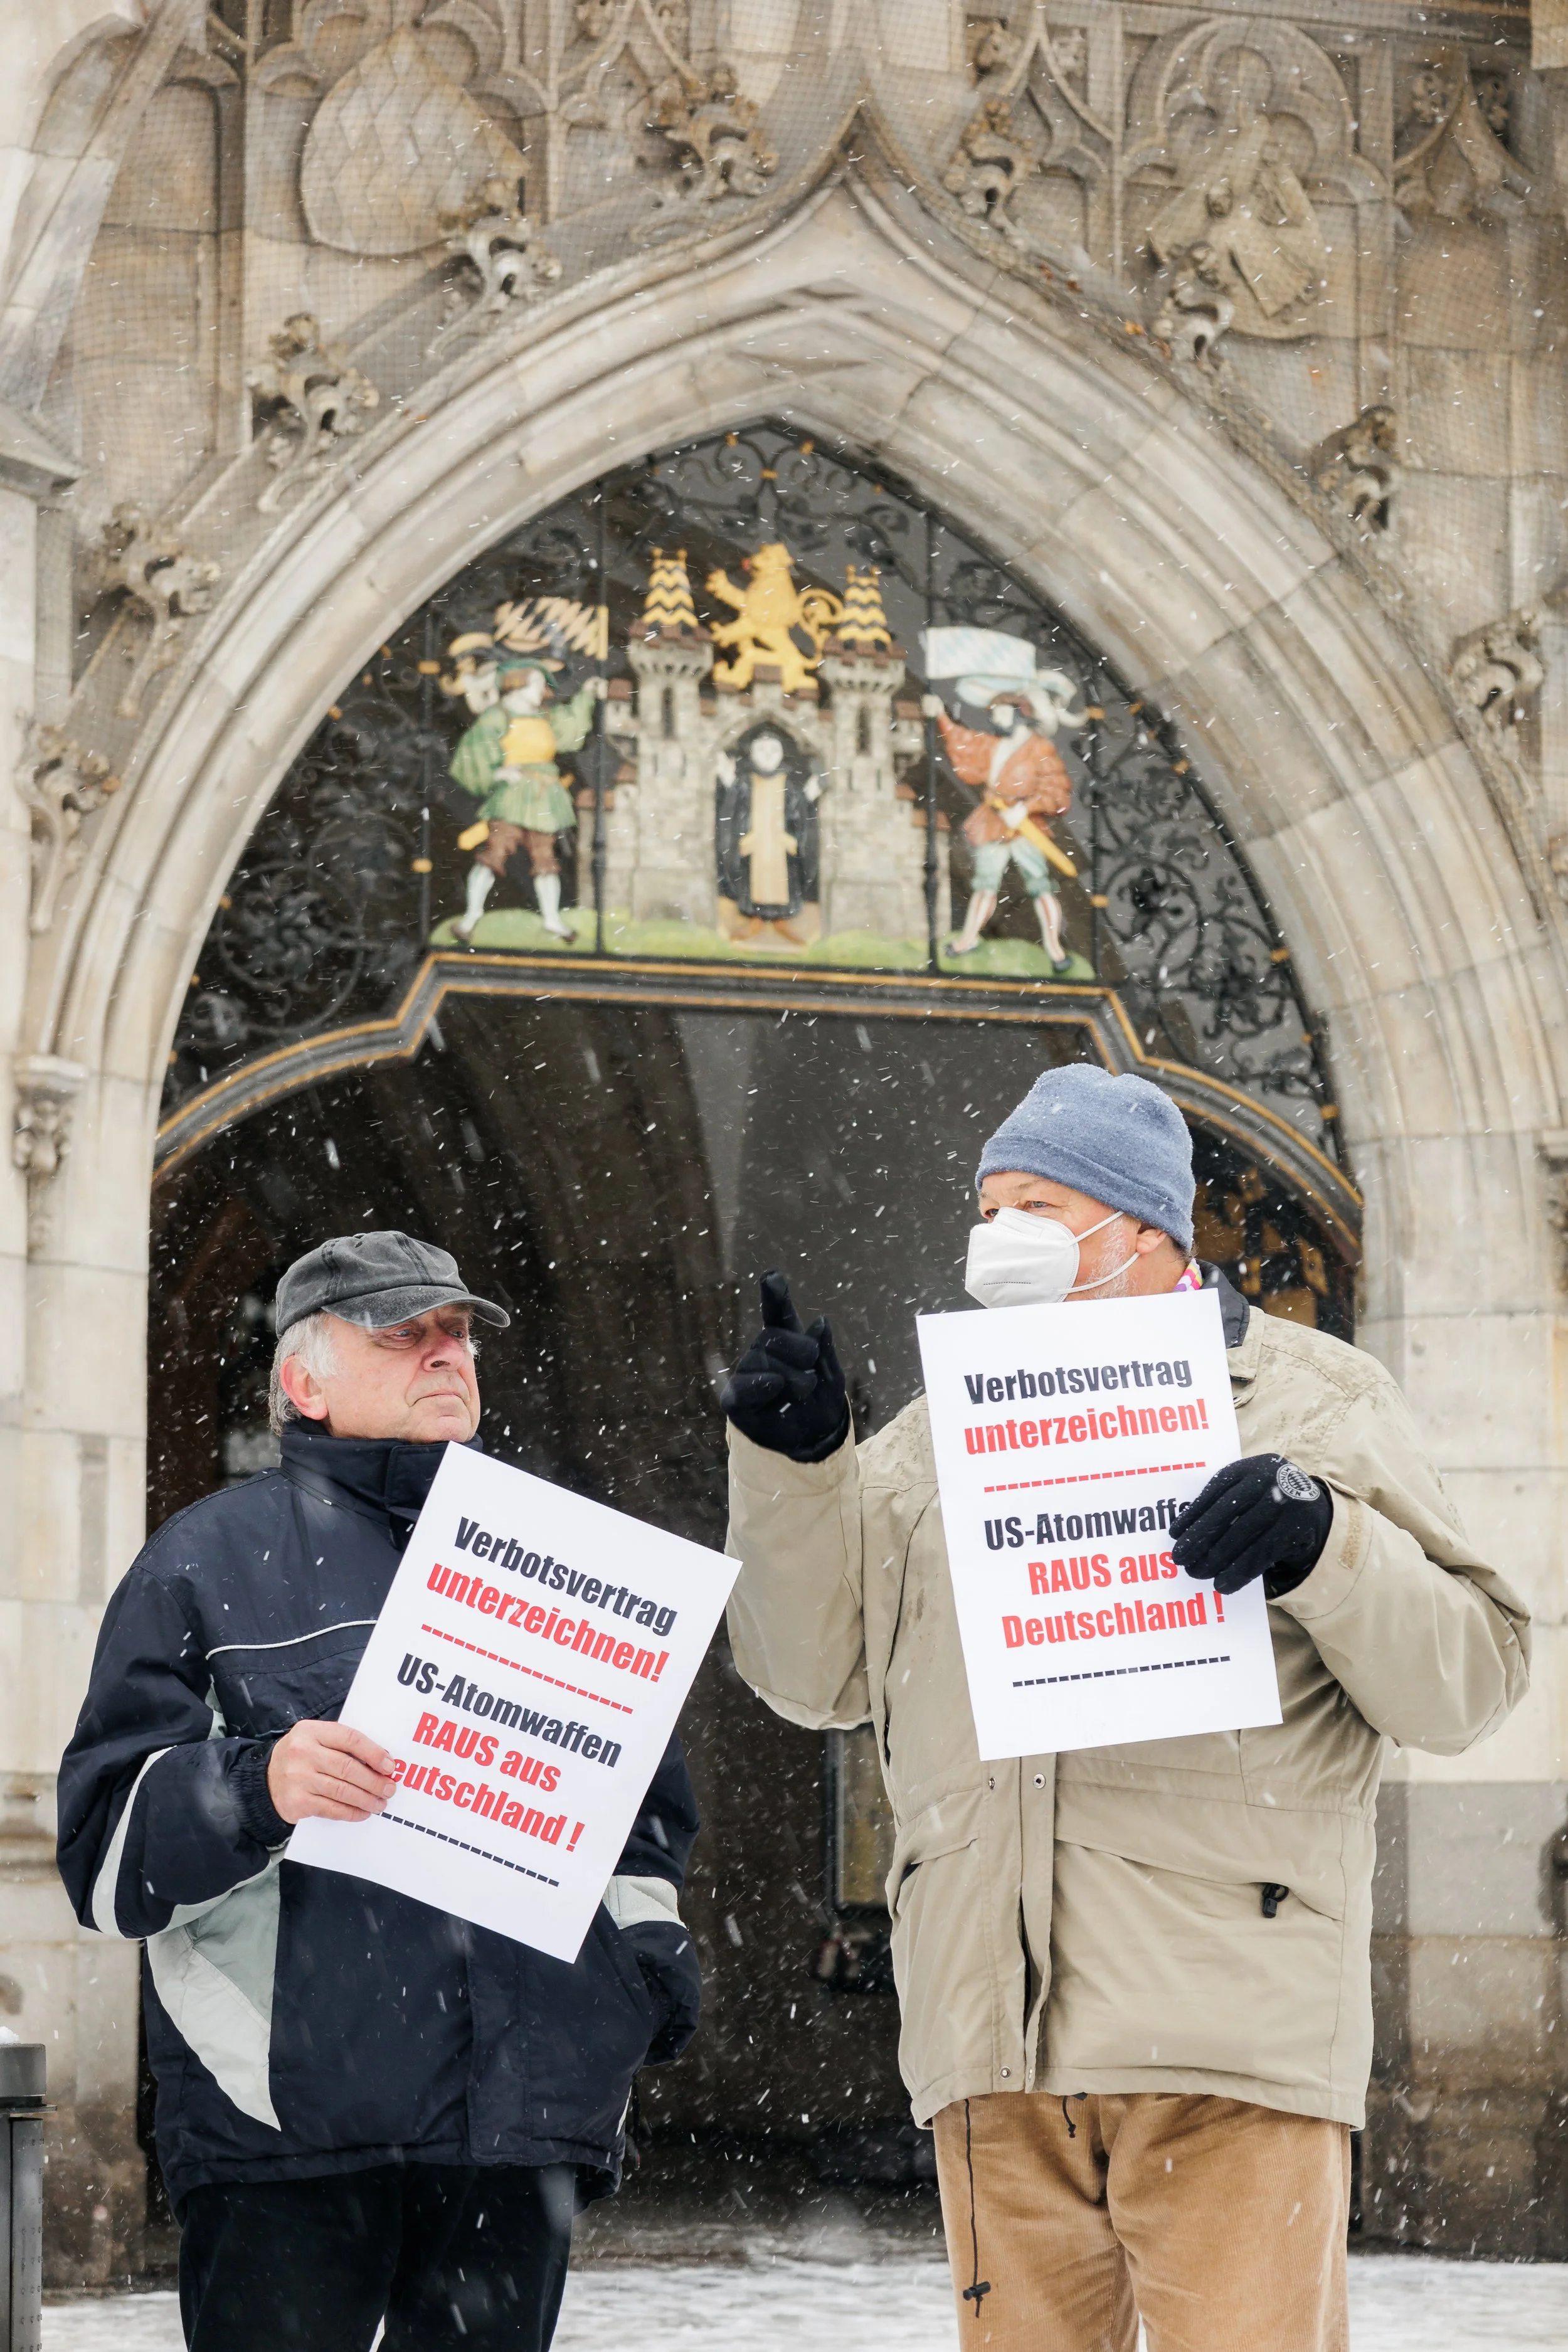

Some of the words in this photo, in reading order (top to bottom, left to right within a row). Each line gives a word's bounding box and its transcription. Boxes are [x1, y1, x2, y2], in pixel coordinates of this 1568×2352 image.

[963, 1359, 1193, 1405] Verbotsvertrag
[964, 1398, 1210, 1455] unterzeichnen!
[983, 1497, 1193, 1551] US-Atomwaff
[453, 1516, 678, 1637] Verbotsvertrag
[1027, 1552, 1112, 1596] RAUS
[1119, 1551, 1179, 1585] aus
[426, 1563, 670, 1683] unterzeichnen!
[1002, 1592, 1207, 1649] Deutschland
[396, 1653, 622, 1769] US-Atomwaffen
[411, 1712, 500, 1767] RAUS
[499, 1750, 562, 1793] aus
[384, 1758, 568, 1846] eutschland
